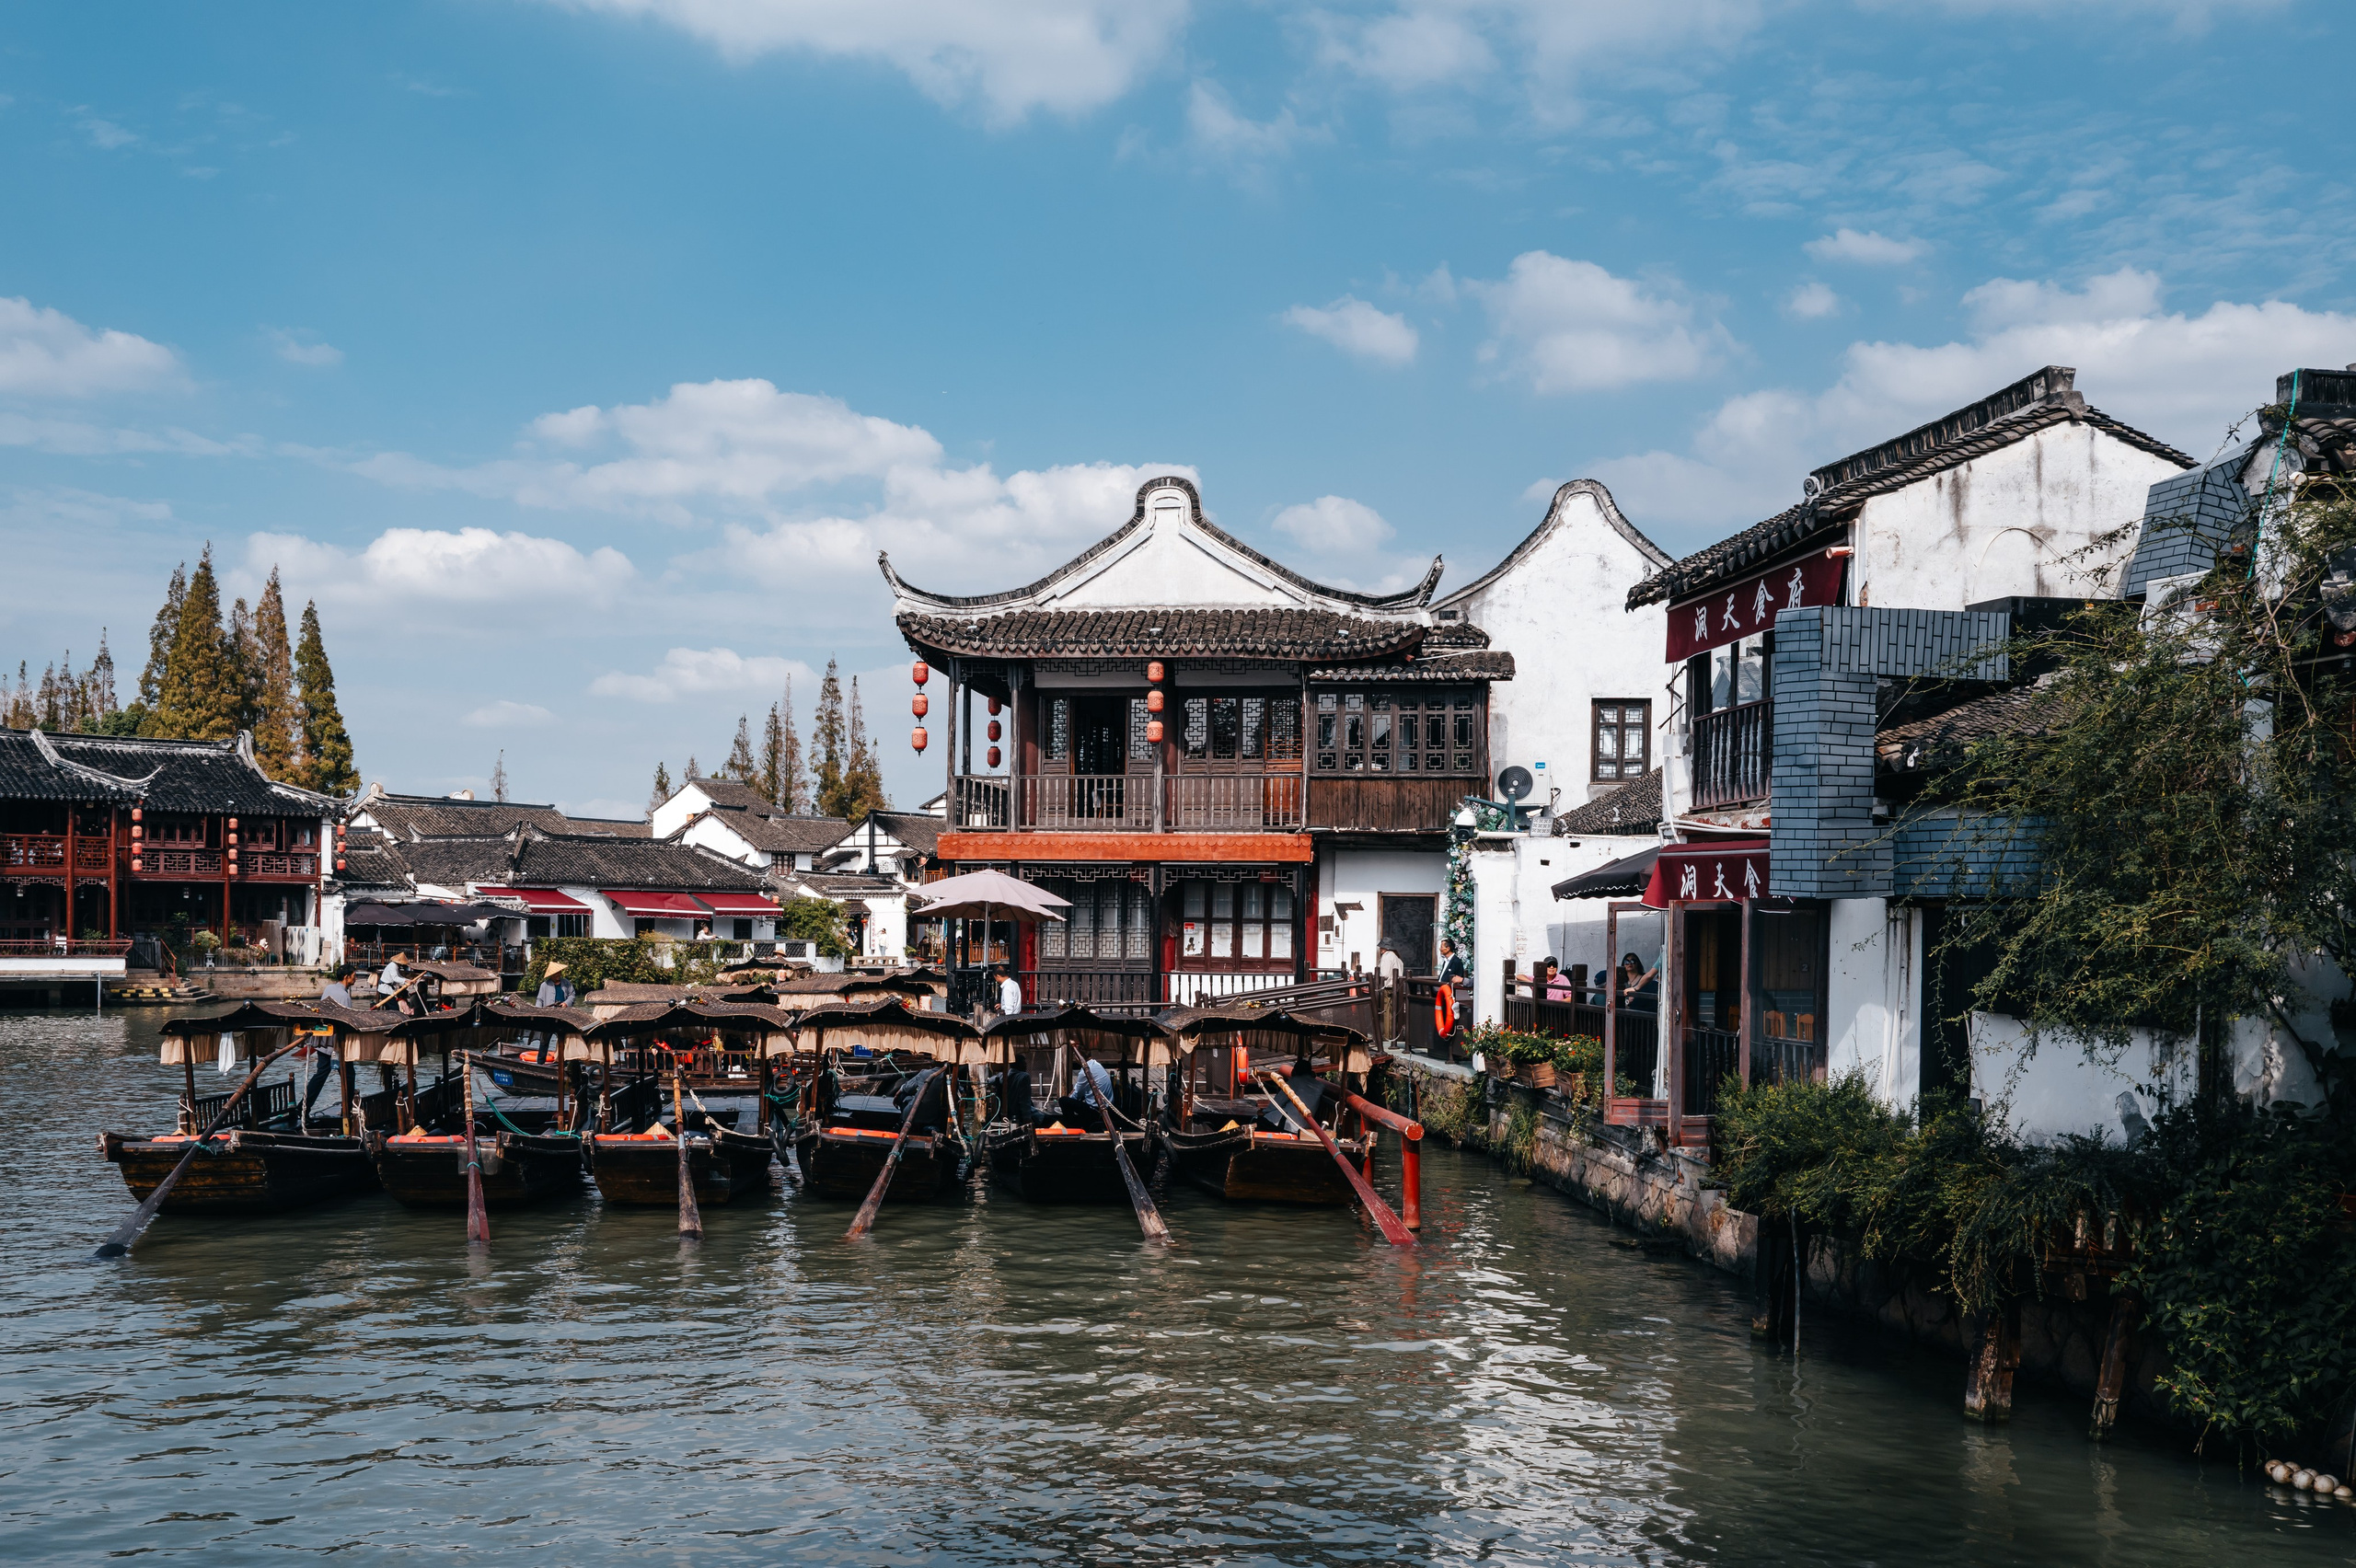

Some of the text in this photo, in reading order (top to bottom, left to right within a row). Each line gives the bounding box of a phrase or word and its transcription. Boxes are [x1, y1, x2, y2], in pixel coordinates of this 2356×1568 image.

[1694, 567, 1805, 642] 洞天食府
[1680, 858, 1782, 901] 洞天食
[1801, 963, 1808, 972] 2
